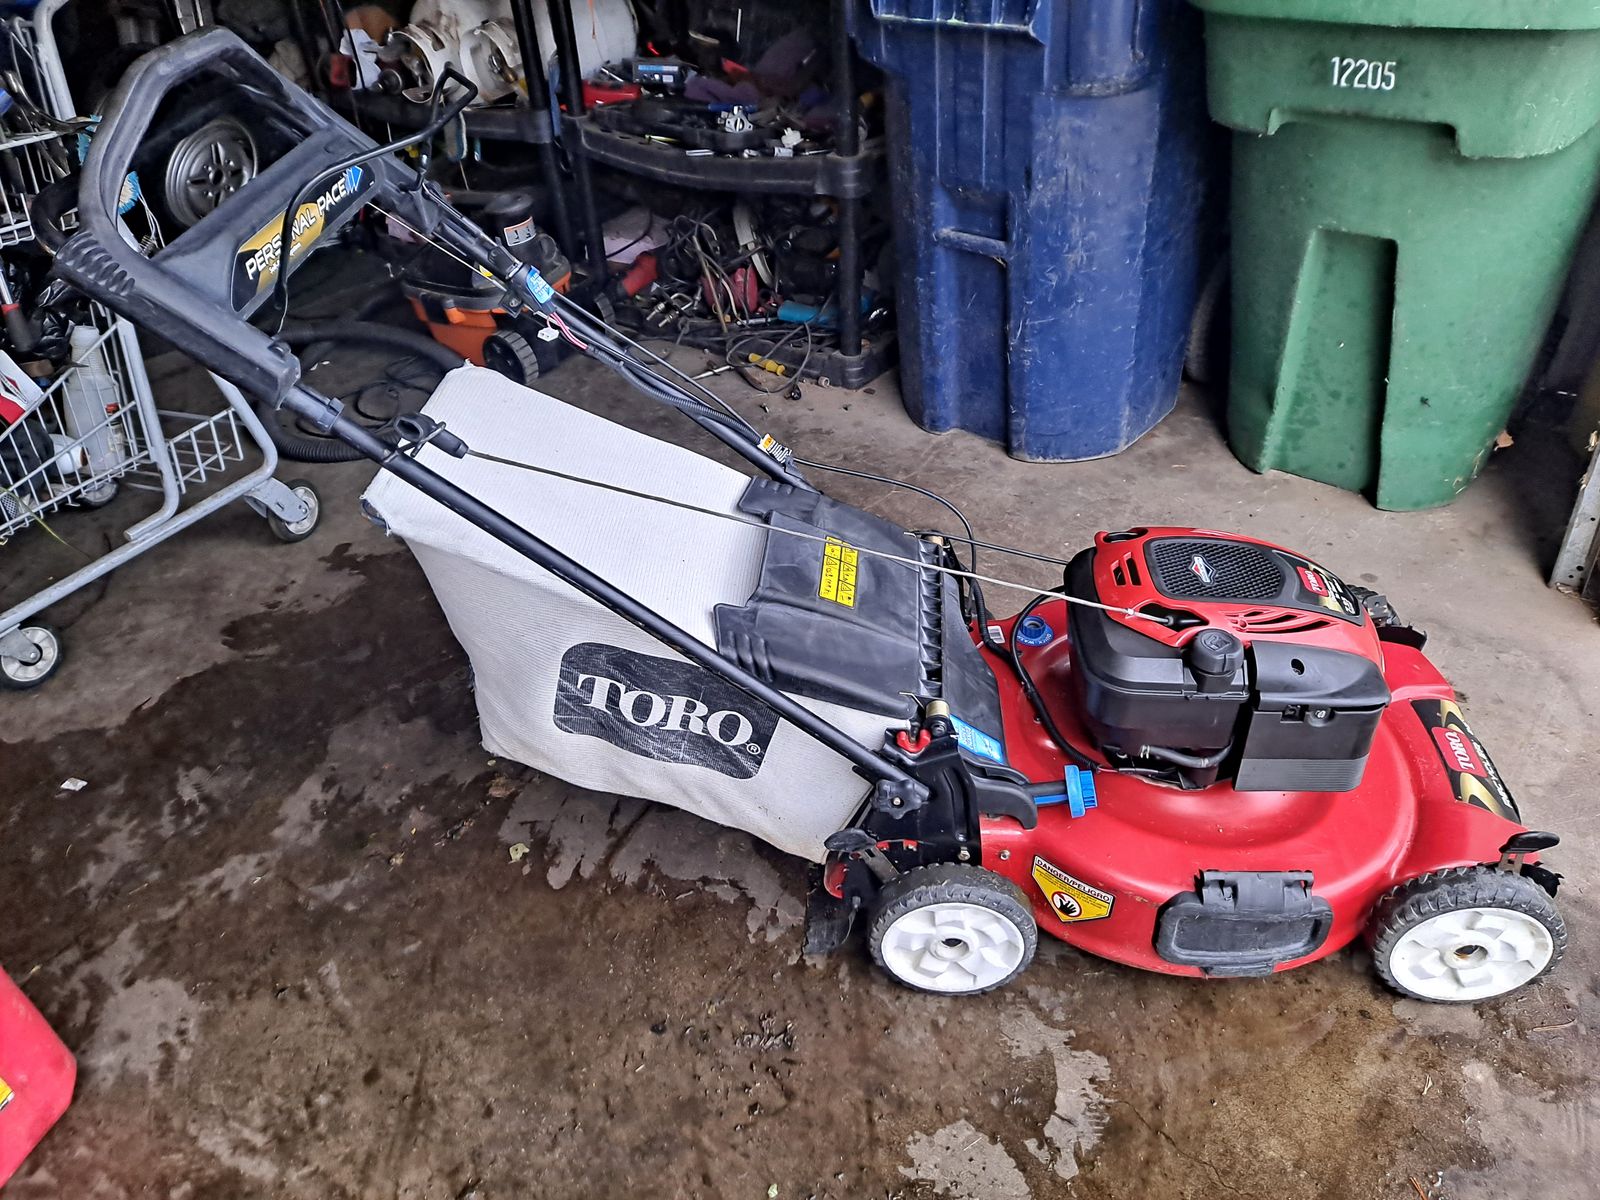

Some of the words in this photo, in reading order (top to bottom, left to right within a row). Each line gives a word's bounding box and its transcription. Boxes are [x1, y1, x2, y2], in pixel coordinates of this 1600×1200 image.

[1330, 56, 1397, 91] 12205
[245, 208, 317, 280] PERSNAL
[316, 177, 347, 217] PACE
[577, 673, 754, 747] TORO
[1445, 731, 1476, 770] TORO
